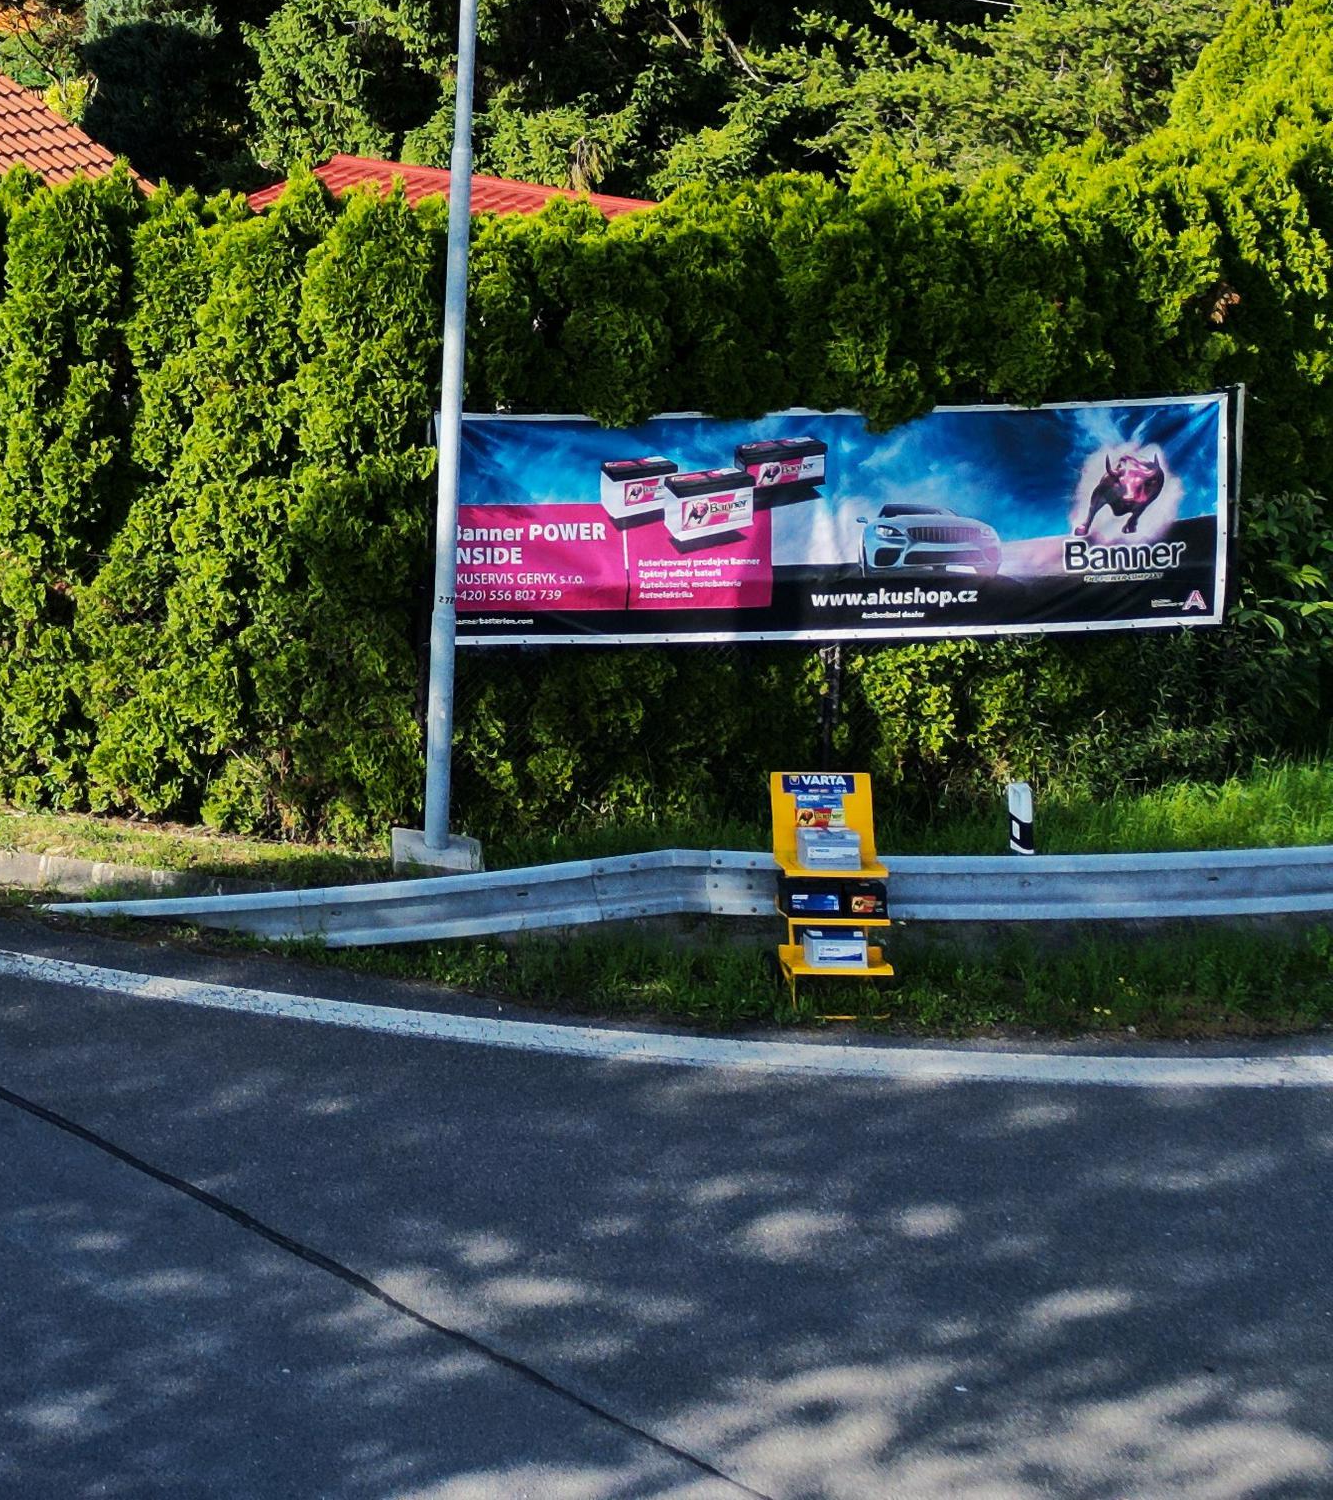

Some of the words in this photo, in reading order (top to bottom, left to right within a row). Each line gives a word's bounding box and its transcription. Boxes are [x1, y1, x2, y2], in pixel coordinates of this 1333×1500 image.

[709, 499, 747, 514] Banner
[457, 524, 523, 542] anner
[528, 522, 606, 541] POWER
[456, 547, 523, 565] NSIDE
[1064, 539, 1186, 573] Banner
[456, 573, 514, 584] KUSERVIS
[517, 573, 556, 584] GERYK
[560, 575, 585, 583] s.r.o.
[454, 590, 486, 602] +420)
[489, 590, 511, 601] 556
[514, 590, 536, 600] 802
[540, 590, 562, 600] 739
[811, 587, 979, 607] www.akushop.cz
[801, 775, 847, 786] VARTA
